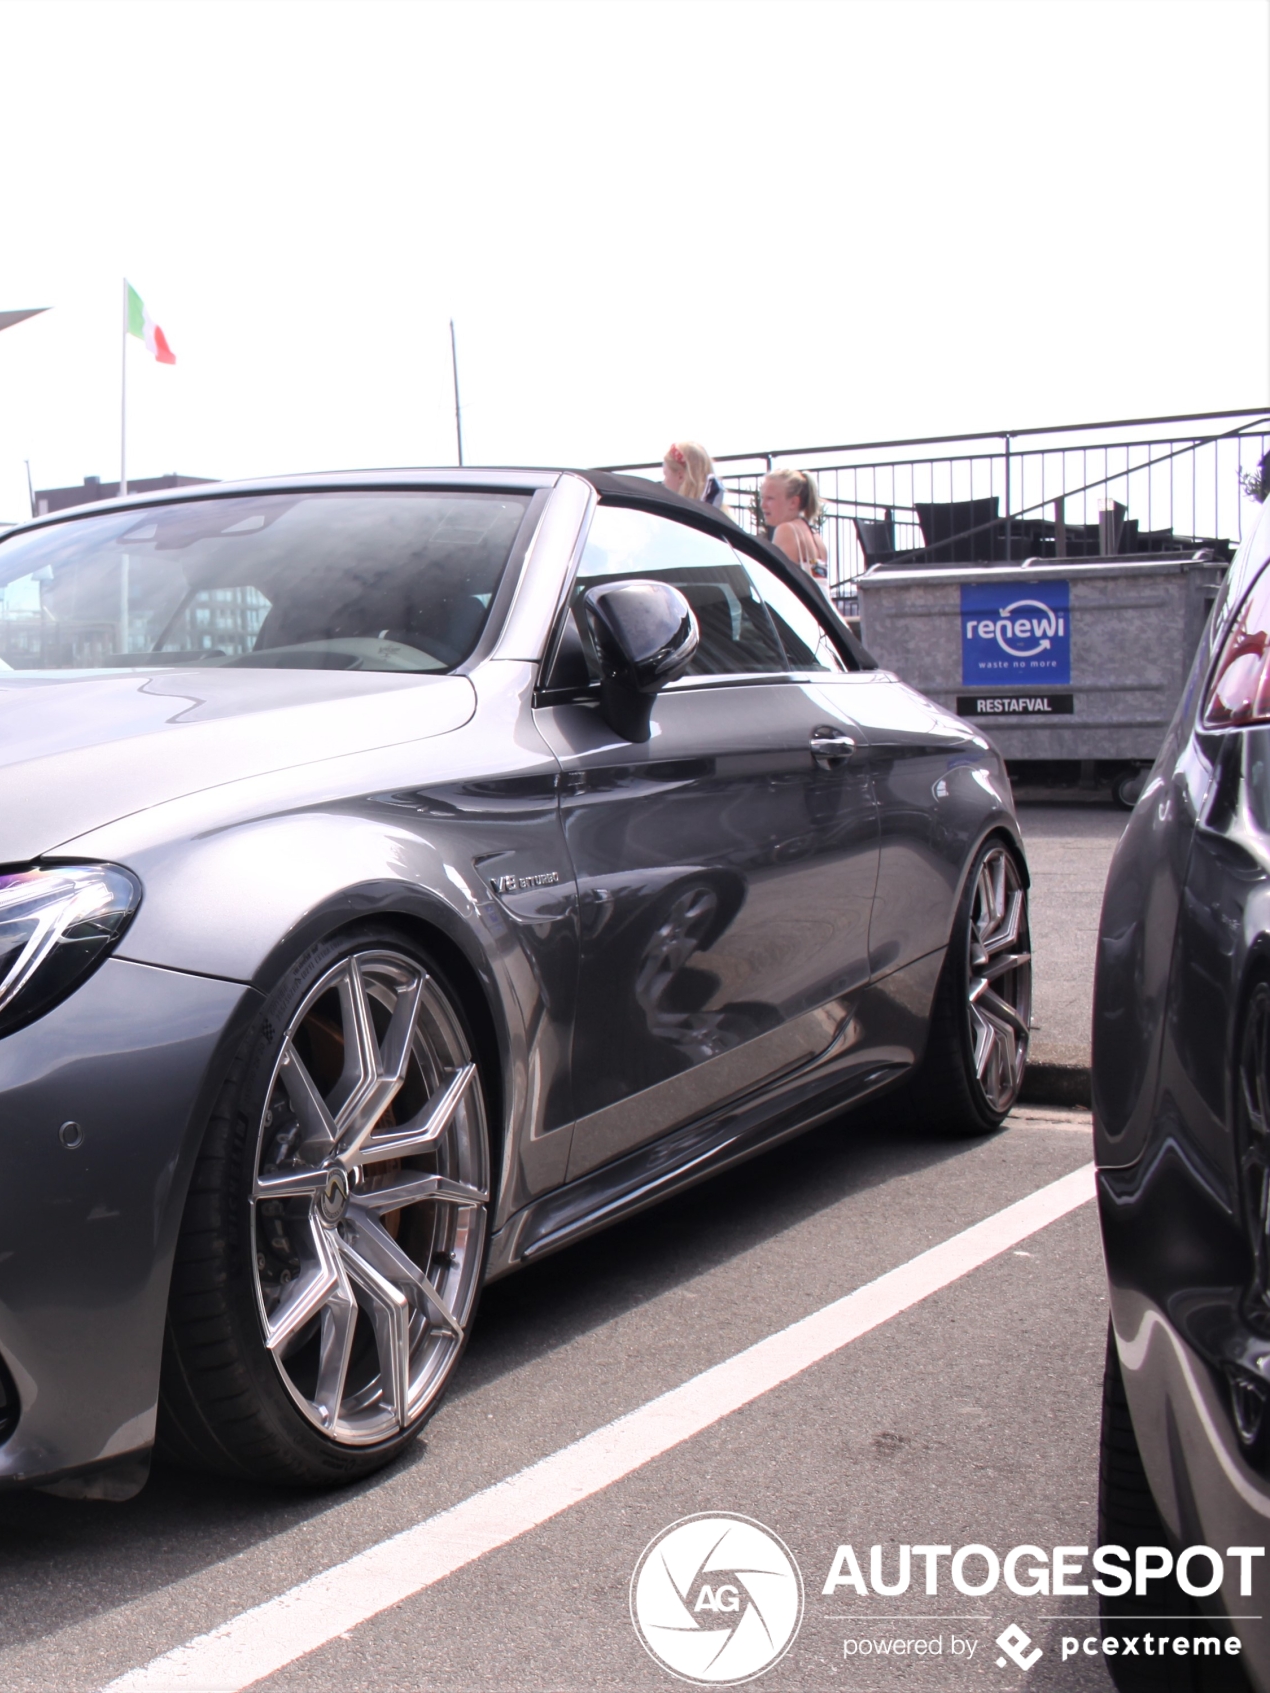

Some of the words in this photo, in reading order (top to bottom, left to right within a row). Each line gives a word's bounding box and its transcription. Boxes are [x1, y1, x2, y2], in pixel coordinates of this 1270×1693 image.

[966, 606, 1064, 645] renewi
[978, 660, 1009, 669] waste
[1013, 660, 1026, 668] no
[1030, 659, 1058, 668] more
[976, 697, 1052, 713] RESTAFVAL
[490, 874, 517, 893] V8
[518, 871, 559, 888] BITURBO
